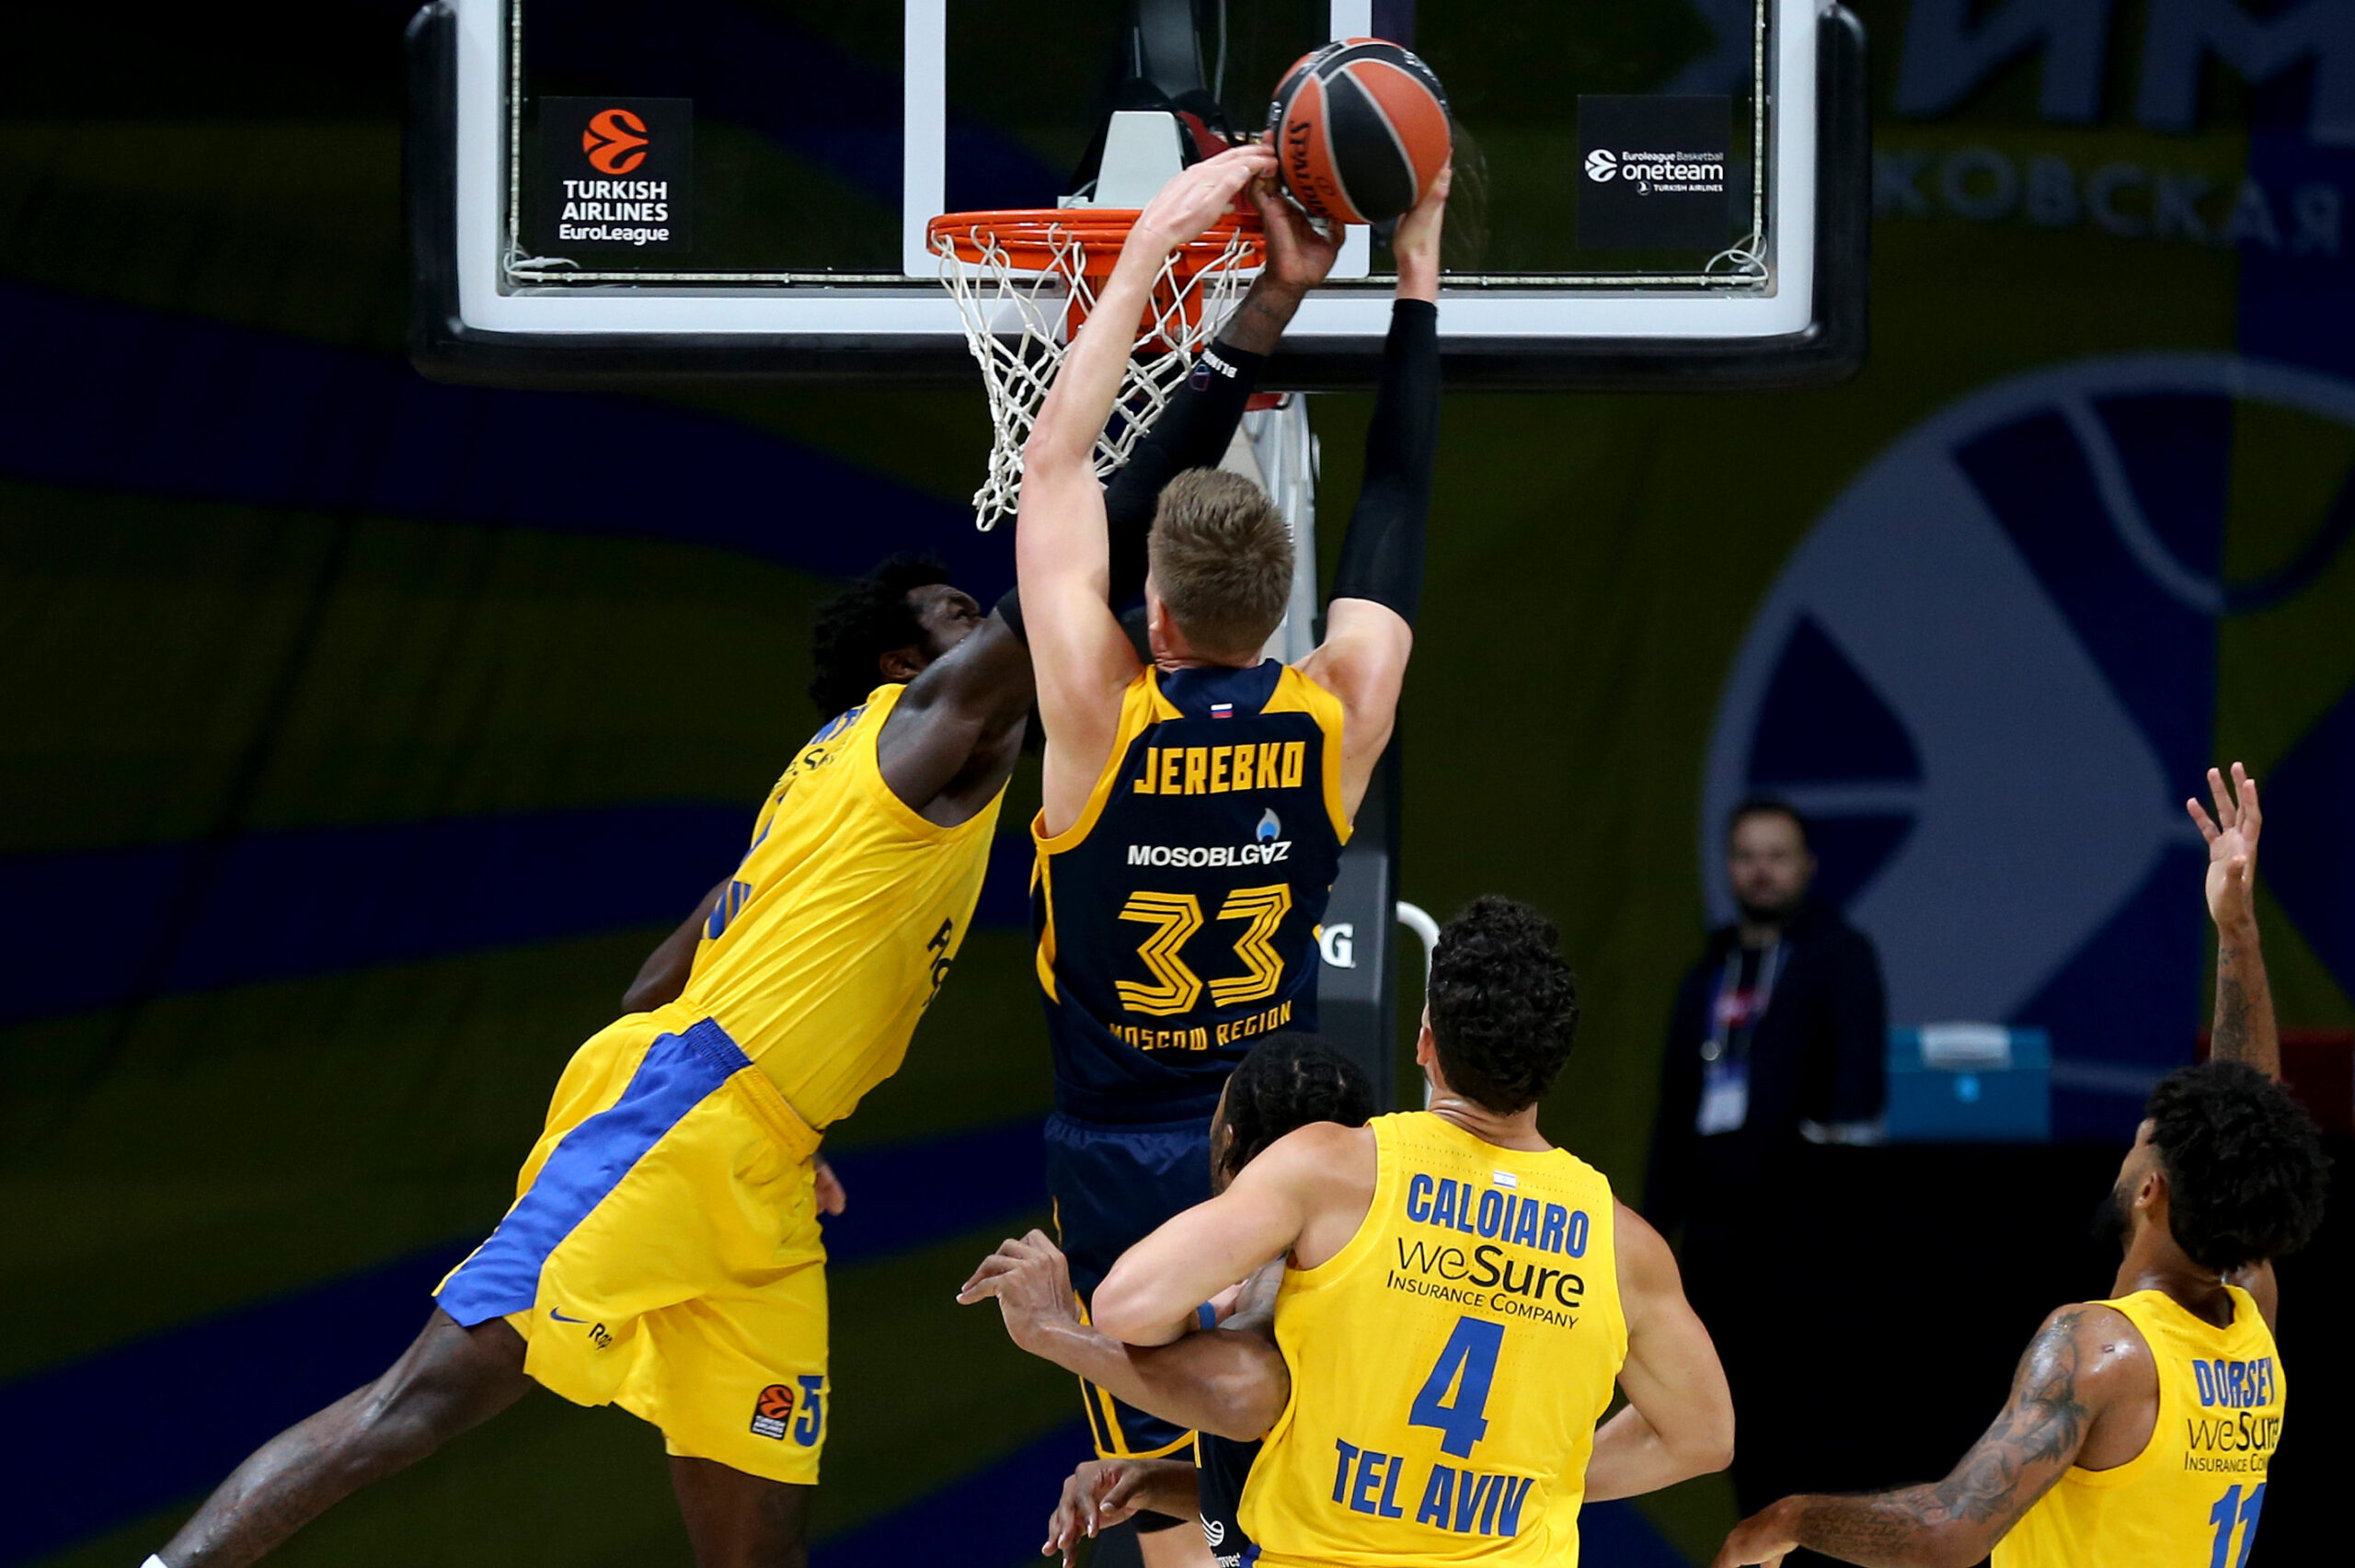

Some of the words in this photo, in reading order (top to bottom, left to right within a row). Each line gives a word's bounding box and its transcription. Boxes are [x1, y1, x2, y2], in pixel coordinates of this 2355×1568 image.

[1622, 151, 1676, 163] Euroleague
[1676, 151, 1724, 161] Basketball
[1622, 161, 1724, 180] oneteam
[560, 201, 669, 222] AIRLINES
[562, 180, 668, 200] TURKISH
[1653, 184, 1687, 192] TURKISH
[1688, 184, 1723, 192] AIRLINES
[559, 223, 670, 246] EuroLeague
[1132, 741, 1305, 795] JEREBKO
[1127, 841, 1292, 867] MOSOBLGAZ
[1114, 882, 1293, 1017] 33
[1109, 1023, 1209, 1051] MOSCOW
[1215, 1000, 1292, 1047] REGION
[1407, 1173, 1591, 1260] CALOIARO
[1396, 1237, 1585, 1308] weSure
[1407, 1315, 1506, 1459] 4
[2191, 1356, 2276, 1408] DORSEY
[793, 1375, 825, 1448] 5
[1331, 1437, 1405, 1520] TEL
[1415, 1463, 1537, 1538] AVIV
[2209, 1482, 2268, 1568] 11
